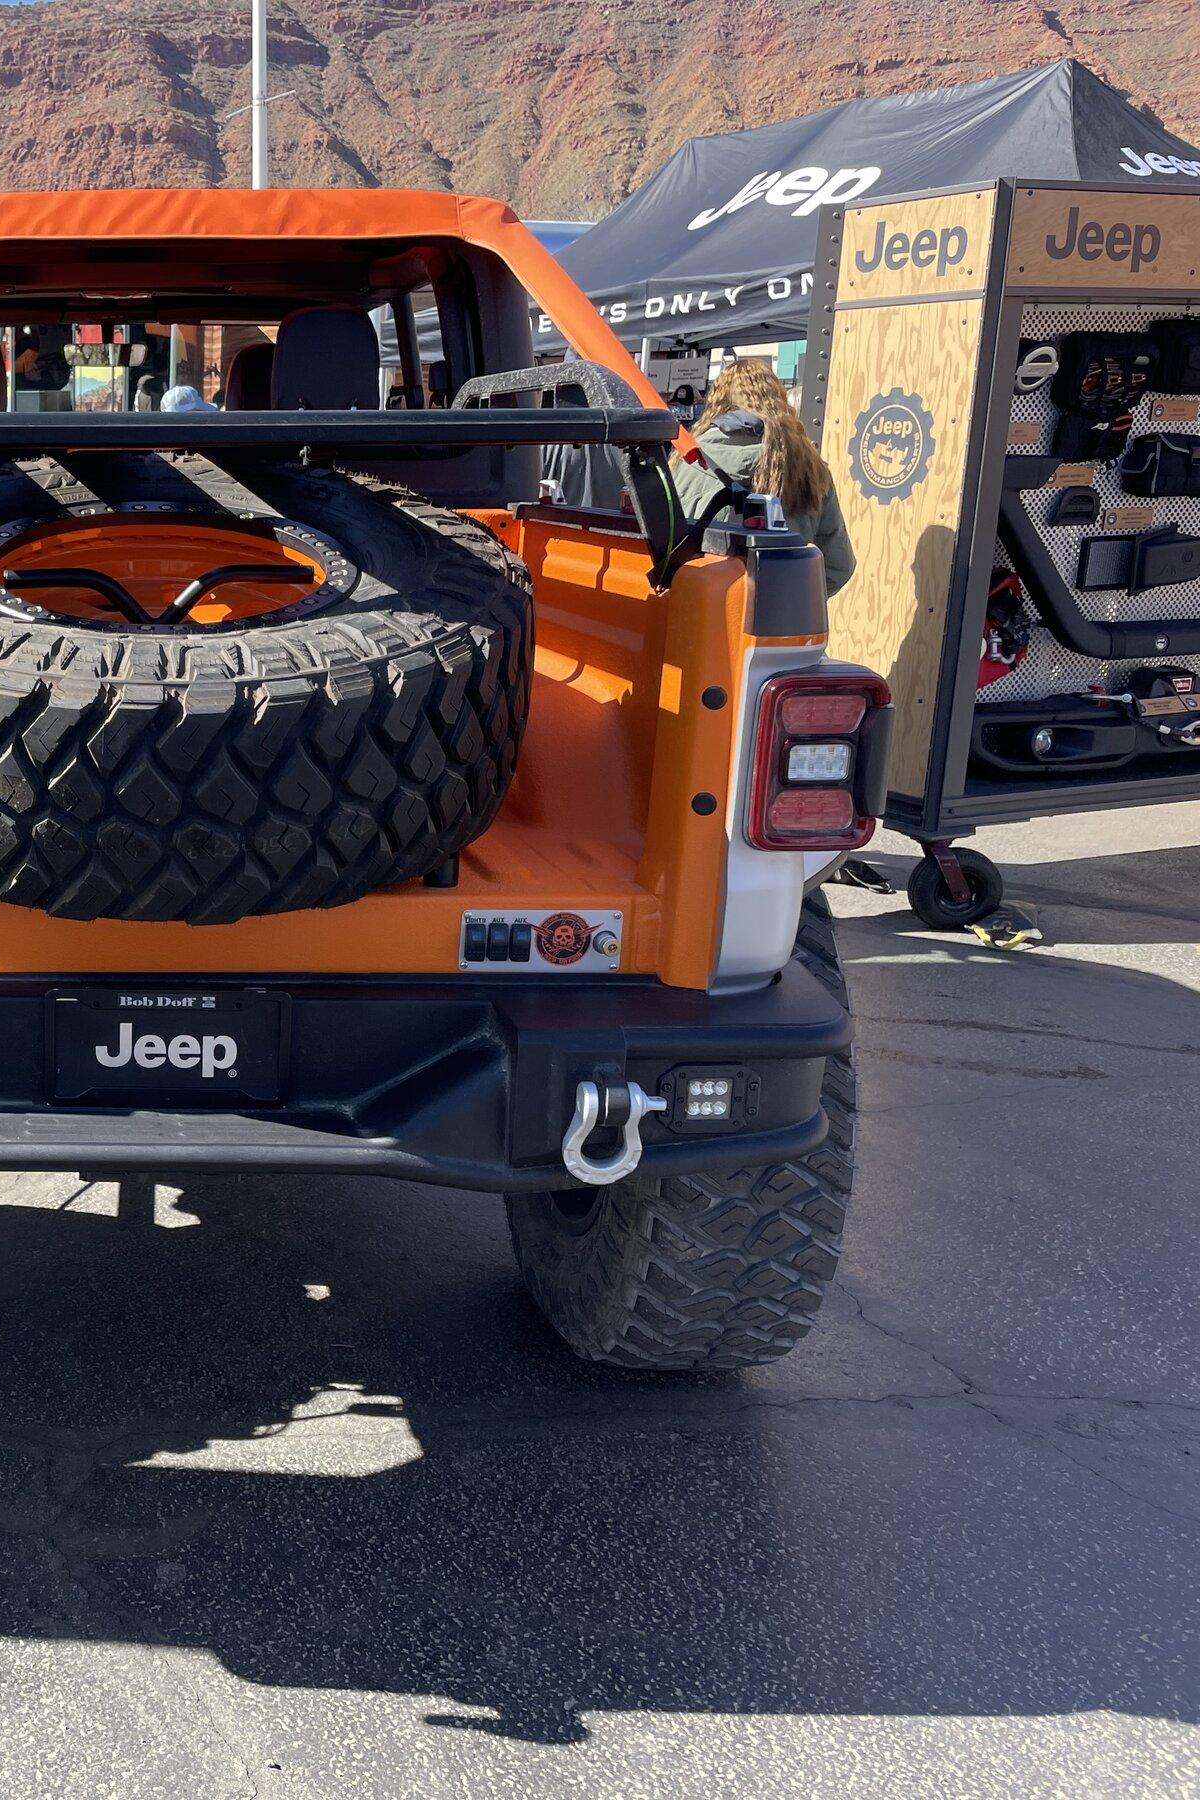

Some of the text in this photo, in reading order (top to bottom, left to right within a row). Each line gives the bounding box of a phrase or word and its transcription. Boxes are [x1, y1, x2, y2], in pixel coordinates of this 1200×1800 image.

[687, 166, 881, 231] Jeep
[855, 221, 968, 277] Jeep
[1045, 206, 1161, 273] Jeep
[645, 285, 745, 318] ONLY
[872, 416, 913, 438] Jeep
[906, 432, 920, 475] PARTS
[120, 996, 154, 1007] Bob
[156, 996, 197, 1007] Doff
[95, 1022, 238, 1078] Jeep
